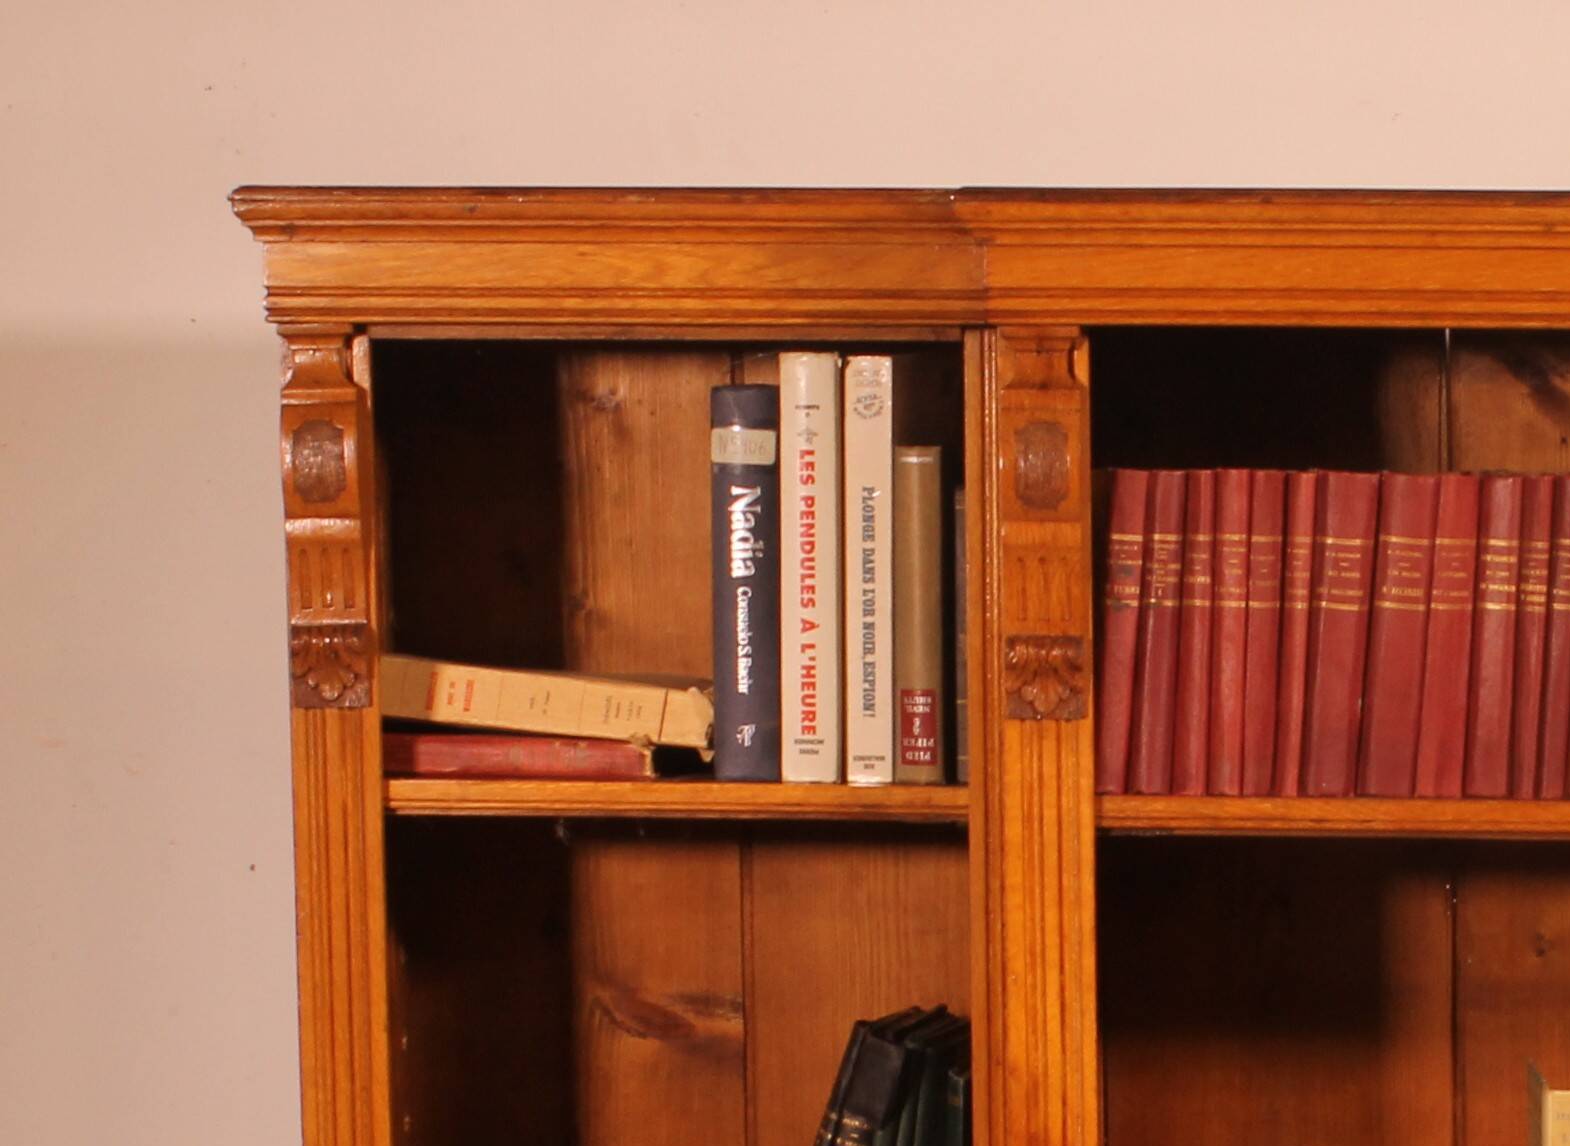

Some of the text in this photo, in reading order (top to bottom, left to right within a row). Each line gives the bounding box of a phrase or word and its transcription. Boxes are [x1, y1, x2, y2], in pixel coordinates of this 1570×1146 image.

[728, 485, 764, 578] Nadia
[861, 486, 876, 542] PLONGE
[800, 449, 819, 737] LES PENDULES À L'HEURE
[862, 548, 876, 585] DANS
[737, 586, 753, 645] Consuelo
